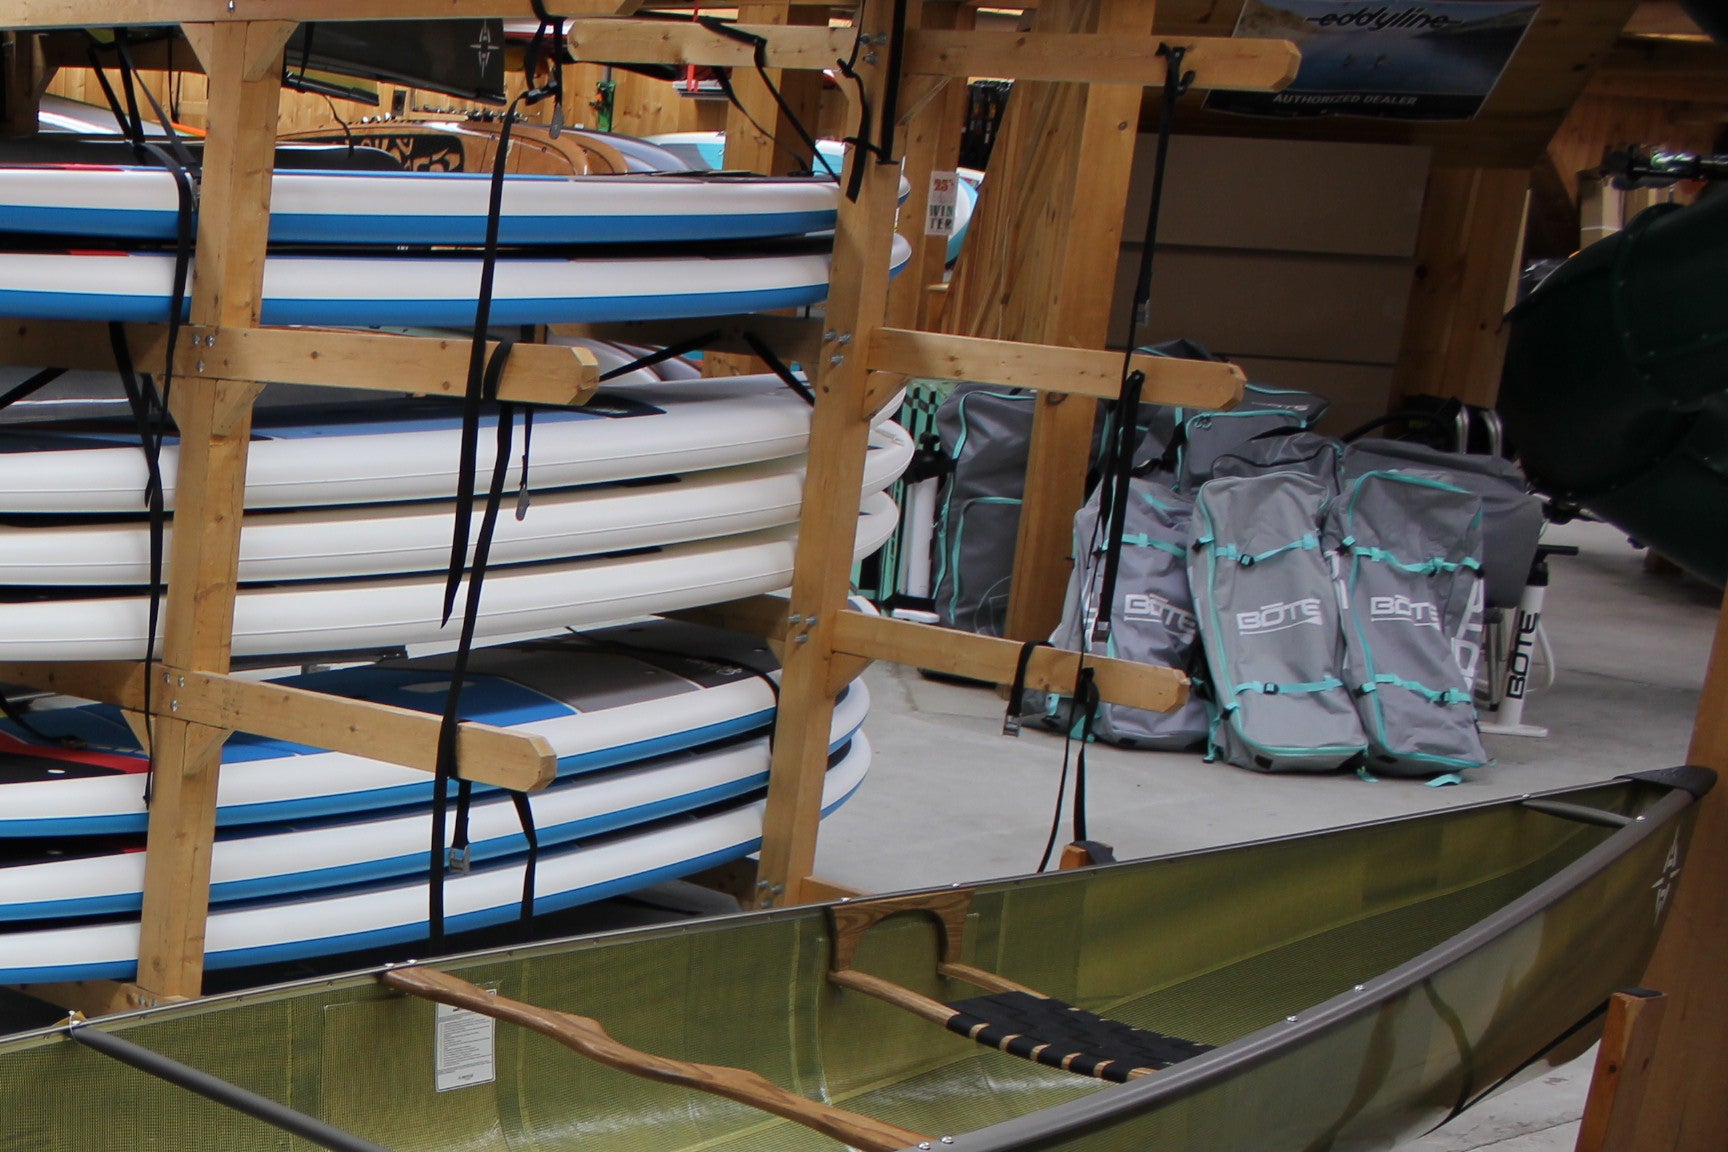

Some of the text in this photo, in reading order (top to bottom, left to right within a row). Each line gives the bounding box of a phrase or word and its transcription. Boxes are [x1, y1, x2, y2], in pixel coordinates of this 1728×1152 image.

[1316, 6, 1452, 32] eddyline
[1273, 93, 1418, 106] AUTHORIZED DEALER
[1506, 609, 1540, 700] BOTE
